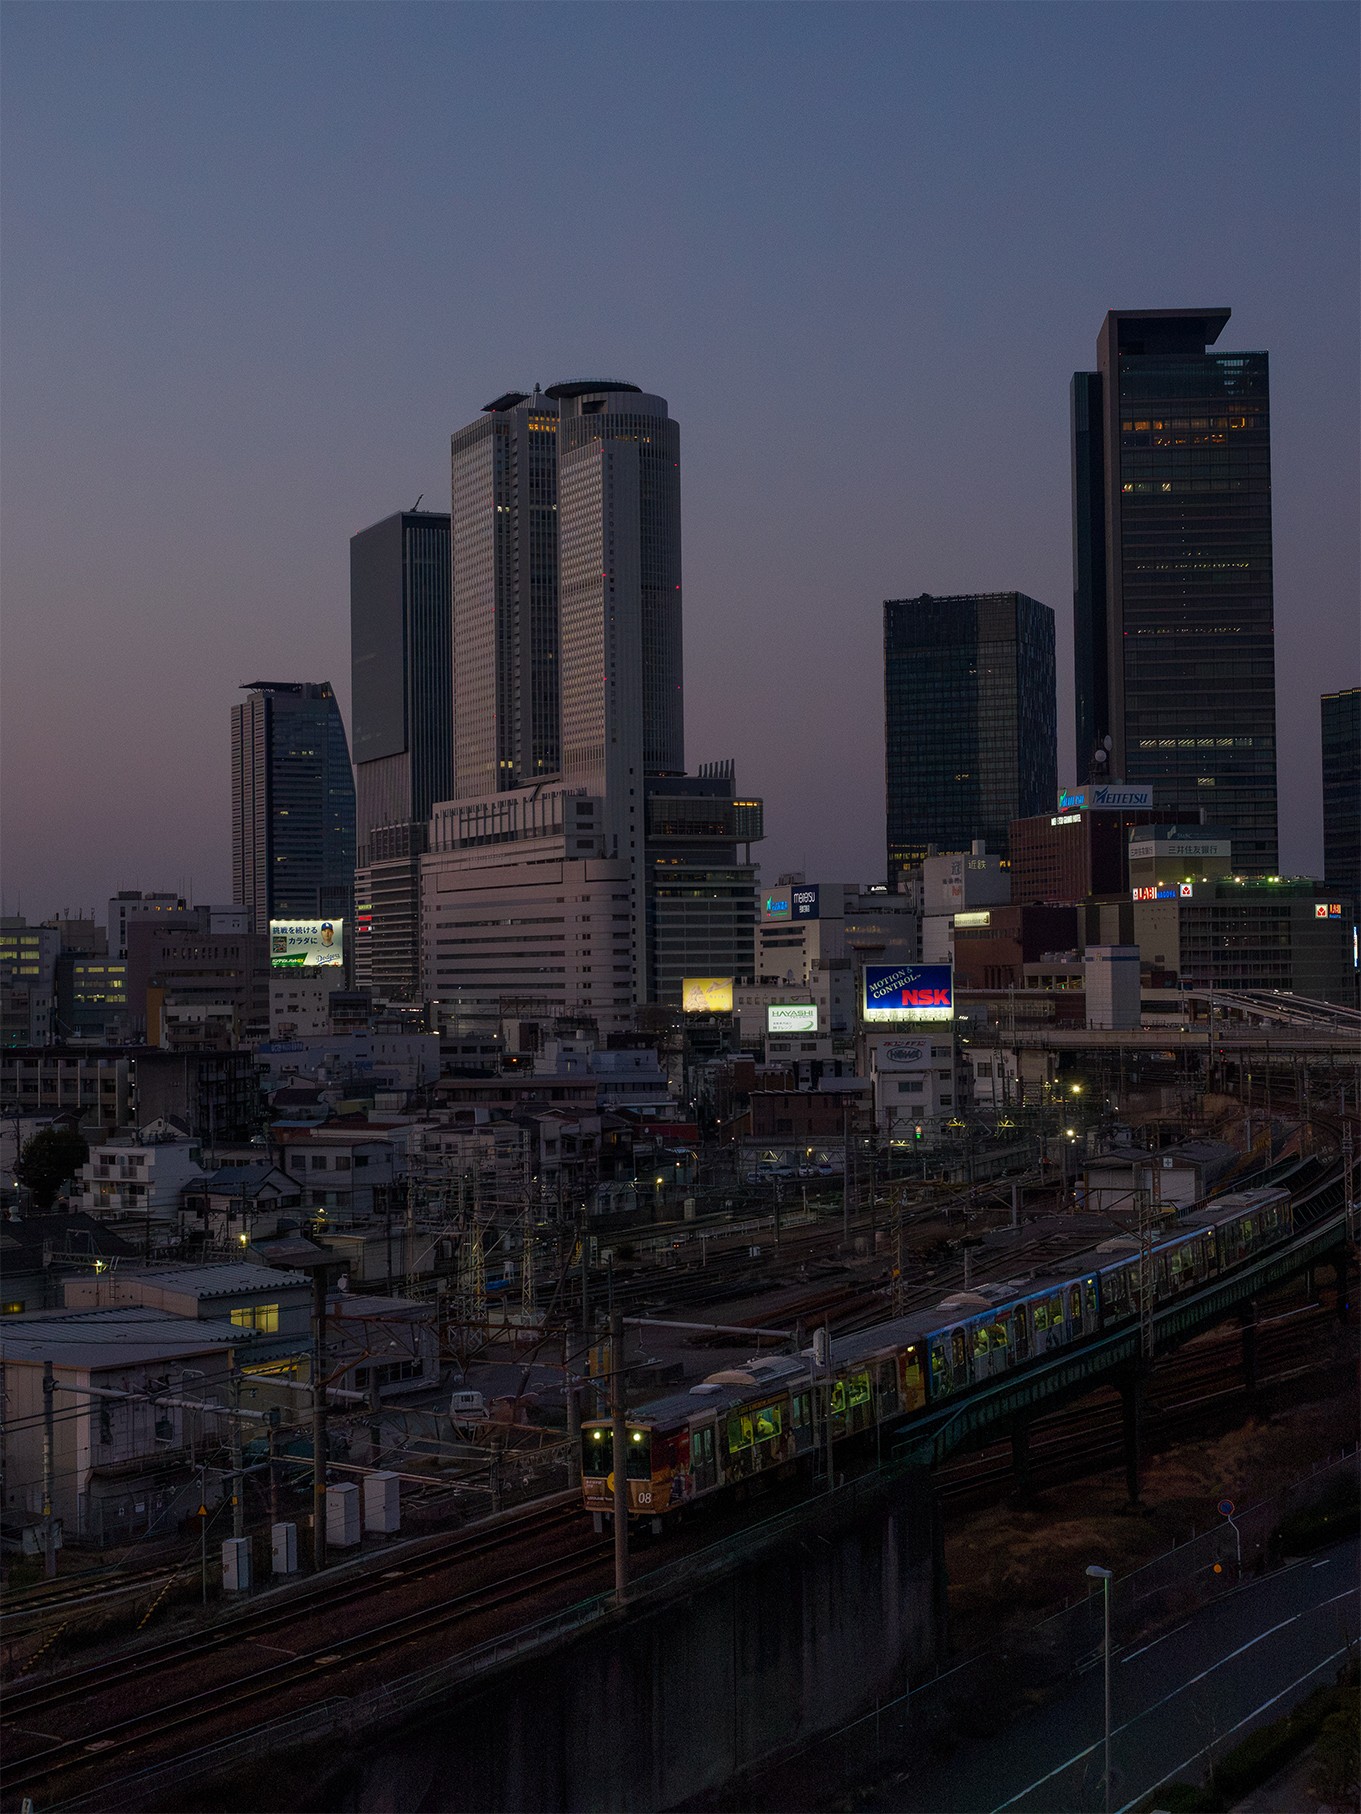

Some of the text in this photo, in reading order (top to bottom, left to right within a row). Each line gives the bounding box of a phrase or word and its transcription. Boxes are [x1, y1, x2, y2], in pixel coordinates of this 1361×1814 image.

[1093, 786, 1148, 805] MEITETSU
[1168, 846, 1217, 855] 三井住友銀行
[968, 859, 987, 870] 近鉄
[1138, 887, 1157, 900] LABI
[272, 926, 318, 935] 挑戦を続ける
[288, 937, 318, 945] カラダに
[869, 966, 913, 992] MOTION &
[902, 989, 951, 1006] NSK
[638, 1493, 652, 1504] 08
